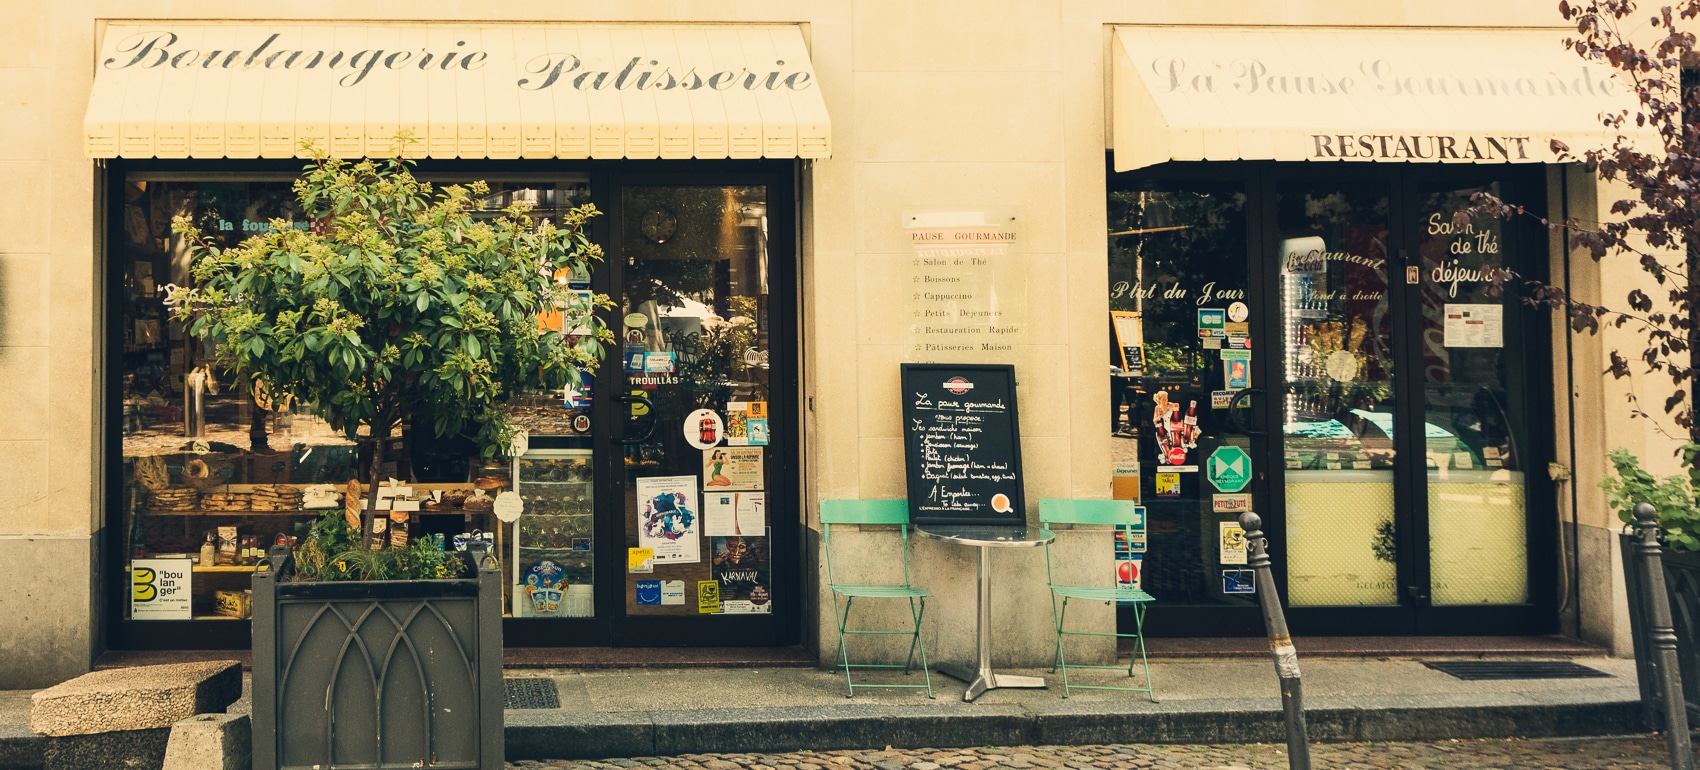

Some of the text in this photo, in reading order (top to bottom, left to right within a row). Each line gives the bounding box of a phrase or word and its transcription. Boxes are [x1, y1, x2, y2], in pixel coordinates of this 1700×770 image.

[103, 31, 812, 93] Boulangerie Patisserie
[1152, 58, 1619, 99] La Pause Gourmande
[1312, 134, 1531, 160] RESTAURANT
[219, 219, 234, 231] la
[912, 232, 1017, 241] PAUSE GOURMANDE
[1450, 229, 1499, 254] de thé
[923, 258, 987, 266] Salon de Thé
[924, 275, 961, 283] Boissons
[924, 292, 973, 301] Cappuccino
[1110, 280, 1245, 306] Plat du Jour
[1352, 290, 1383, 301] droite
[925, 308, 1003, 318] Petits Déjeuners
[925, 325, 1019, 335] Restauration Rapide
[925, 342, 1012, 351] Pâtisseries Maison
[630, 376, 679, 385] TROUILLAS
[915, 392, 1006, 413] La pause gourmande
[159, 578, 175, 587] lan
[720, 570, 758, 586] KARNAVAL
[159, 586, 182, 597] ger"
